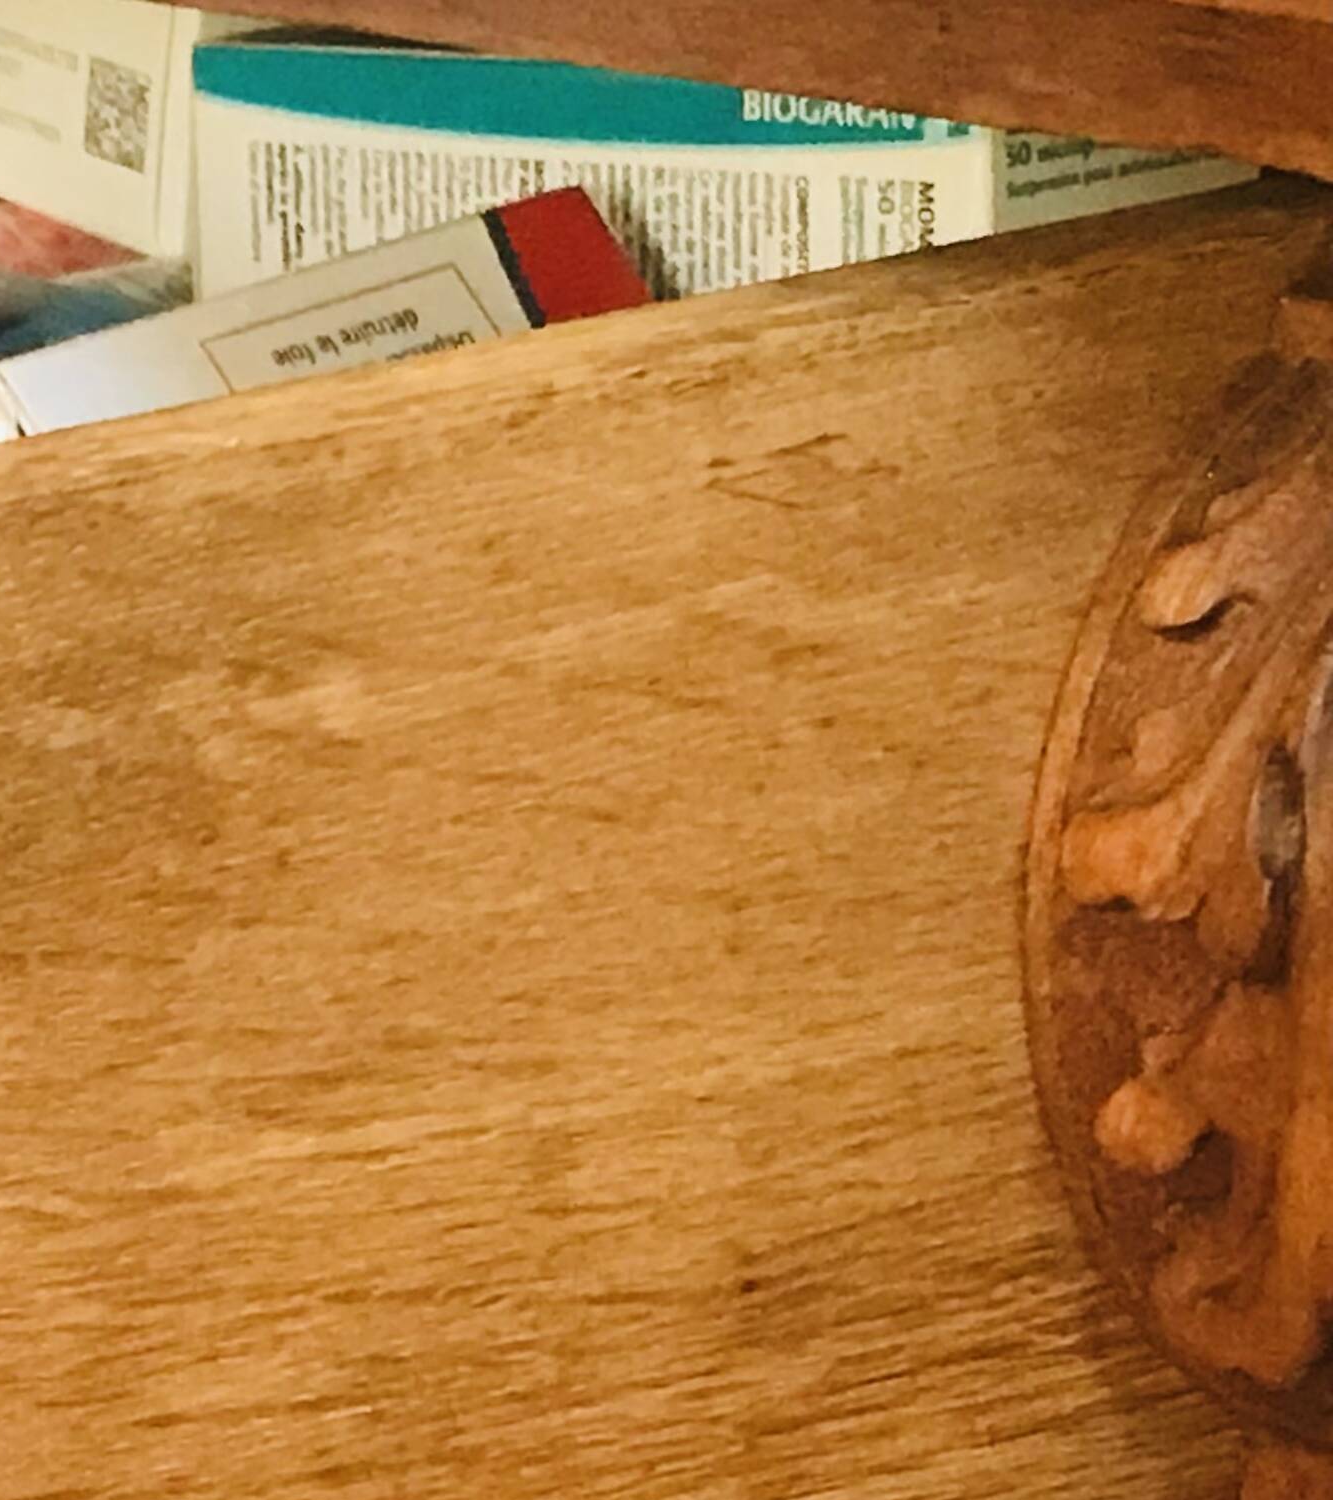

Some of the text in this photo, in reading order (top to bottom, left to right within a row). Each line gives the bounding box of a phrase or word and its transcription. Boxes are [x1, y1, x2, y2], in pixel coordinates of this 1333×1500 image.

[270, 309, 419, 370] détruire le foie
